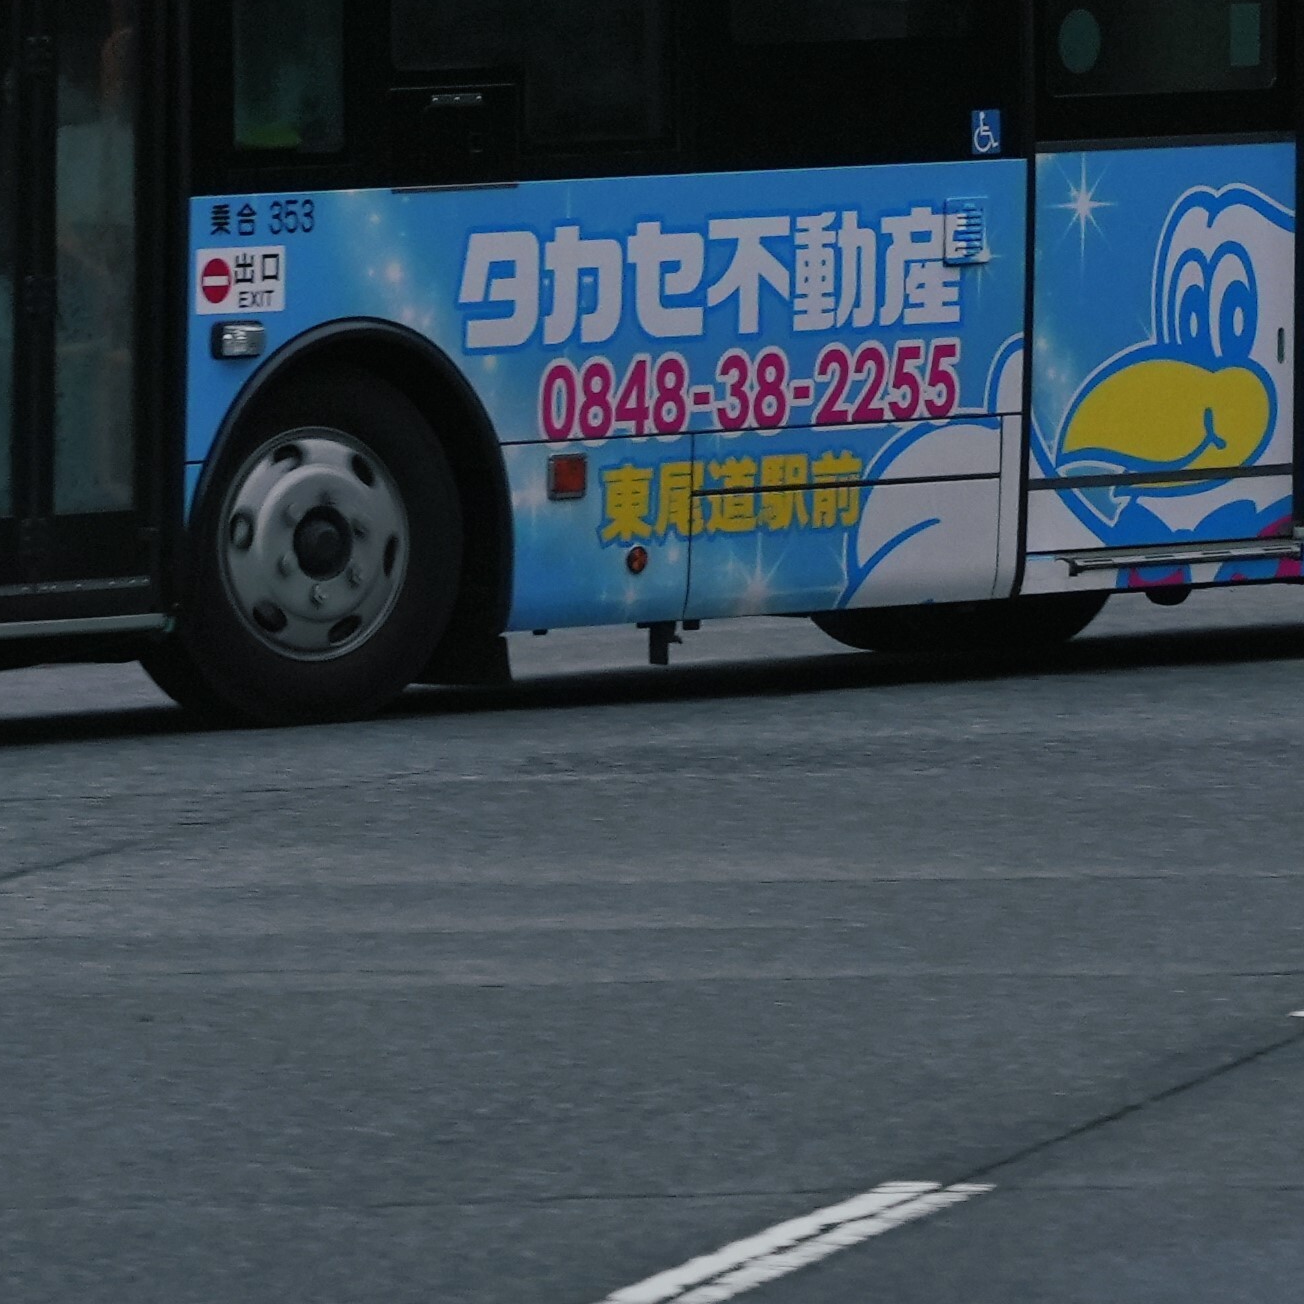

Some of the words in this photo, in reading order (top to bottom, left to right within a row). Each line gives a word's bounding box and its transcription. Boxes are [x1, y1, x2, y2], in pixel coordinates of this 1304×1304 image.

[268, 199, 316, 235] 353
[234, 252, 280, 285] 出口
[238, 289, 275, 309] EXIT
[456, 205, 963, 348] タカセ不動産
[539, 341, 960, 441] 0848-38-2255
[599, 448, 862, 546] 東尾道駅前
